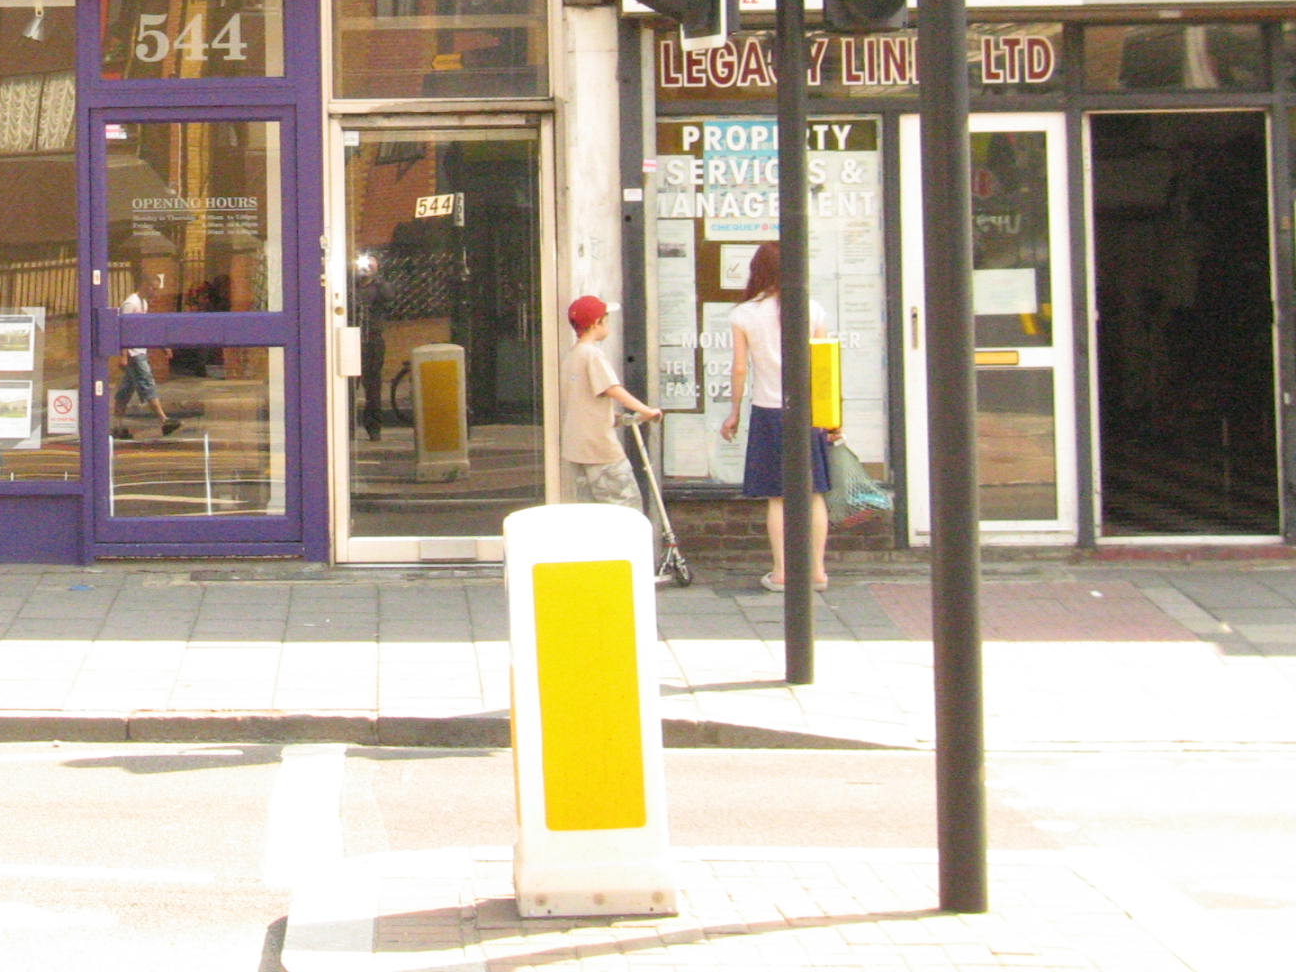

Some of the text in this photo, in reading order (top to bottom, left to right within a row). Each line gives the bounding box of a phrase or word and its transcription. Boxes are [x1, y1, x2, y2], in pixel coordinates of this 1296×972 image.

[135, 13, 248, 62] 544
[661, 35, 1055, 87] LEGAY LIN LTD
[683, 125, 852, 151] PROPTY
[666, 158, 864, 184] SERVICS &
[131, 196, 257, 210] OPENING HOURS
[417, 195, 452, 216] 544
